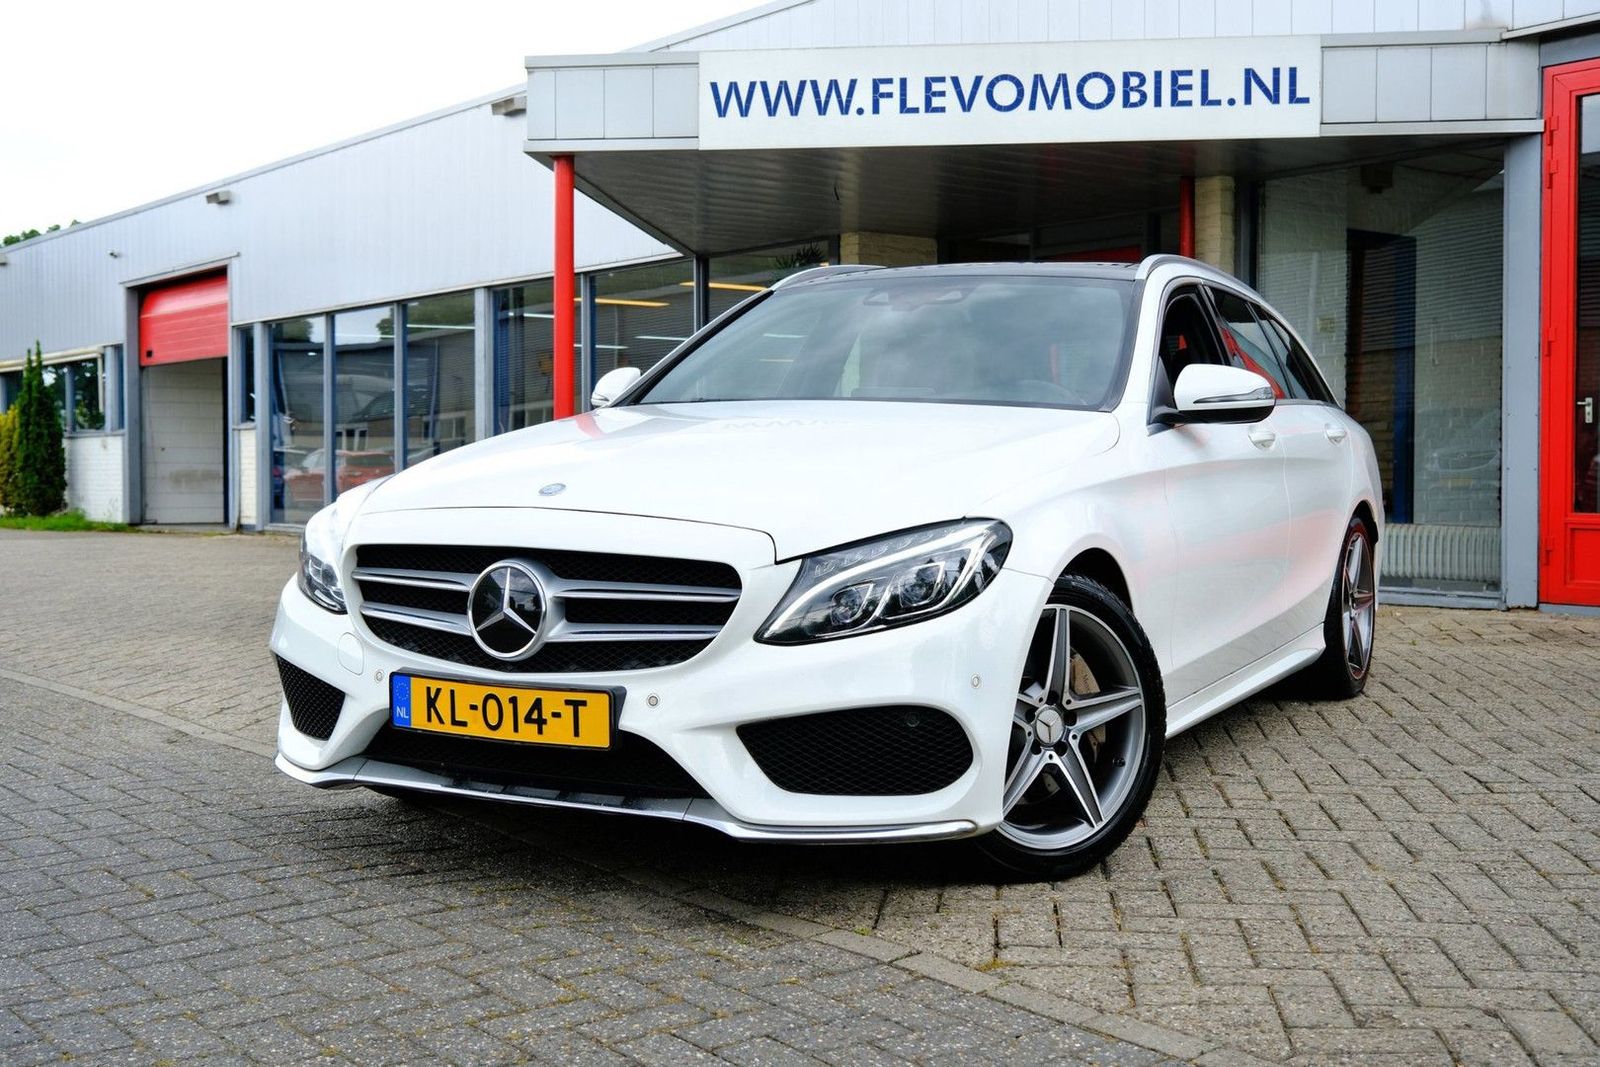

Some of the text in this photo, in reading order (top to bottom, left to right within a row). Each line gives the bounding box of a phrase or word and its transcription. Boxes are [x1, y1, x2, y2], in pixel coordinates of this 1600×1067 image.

[709, 66, 1311, 118] WWW.FLEVOMOBIEL.NL
[396, 705, 409, 719] NL
[425, 686, 588, 738] KL-014-T
